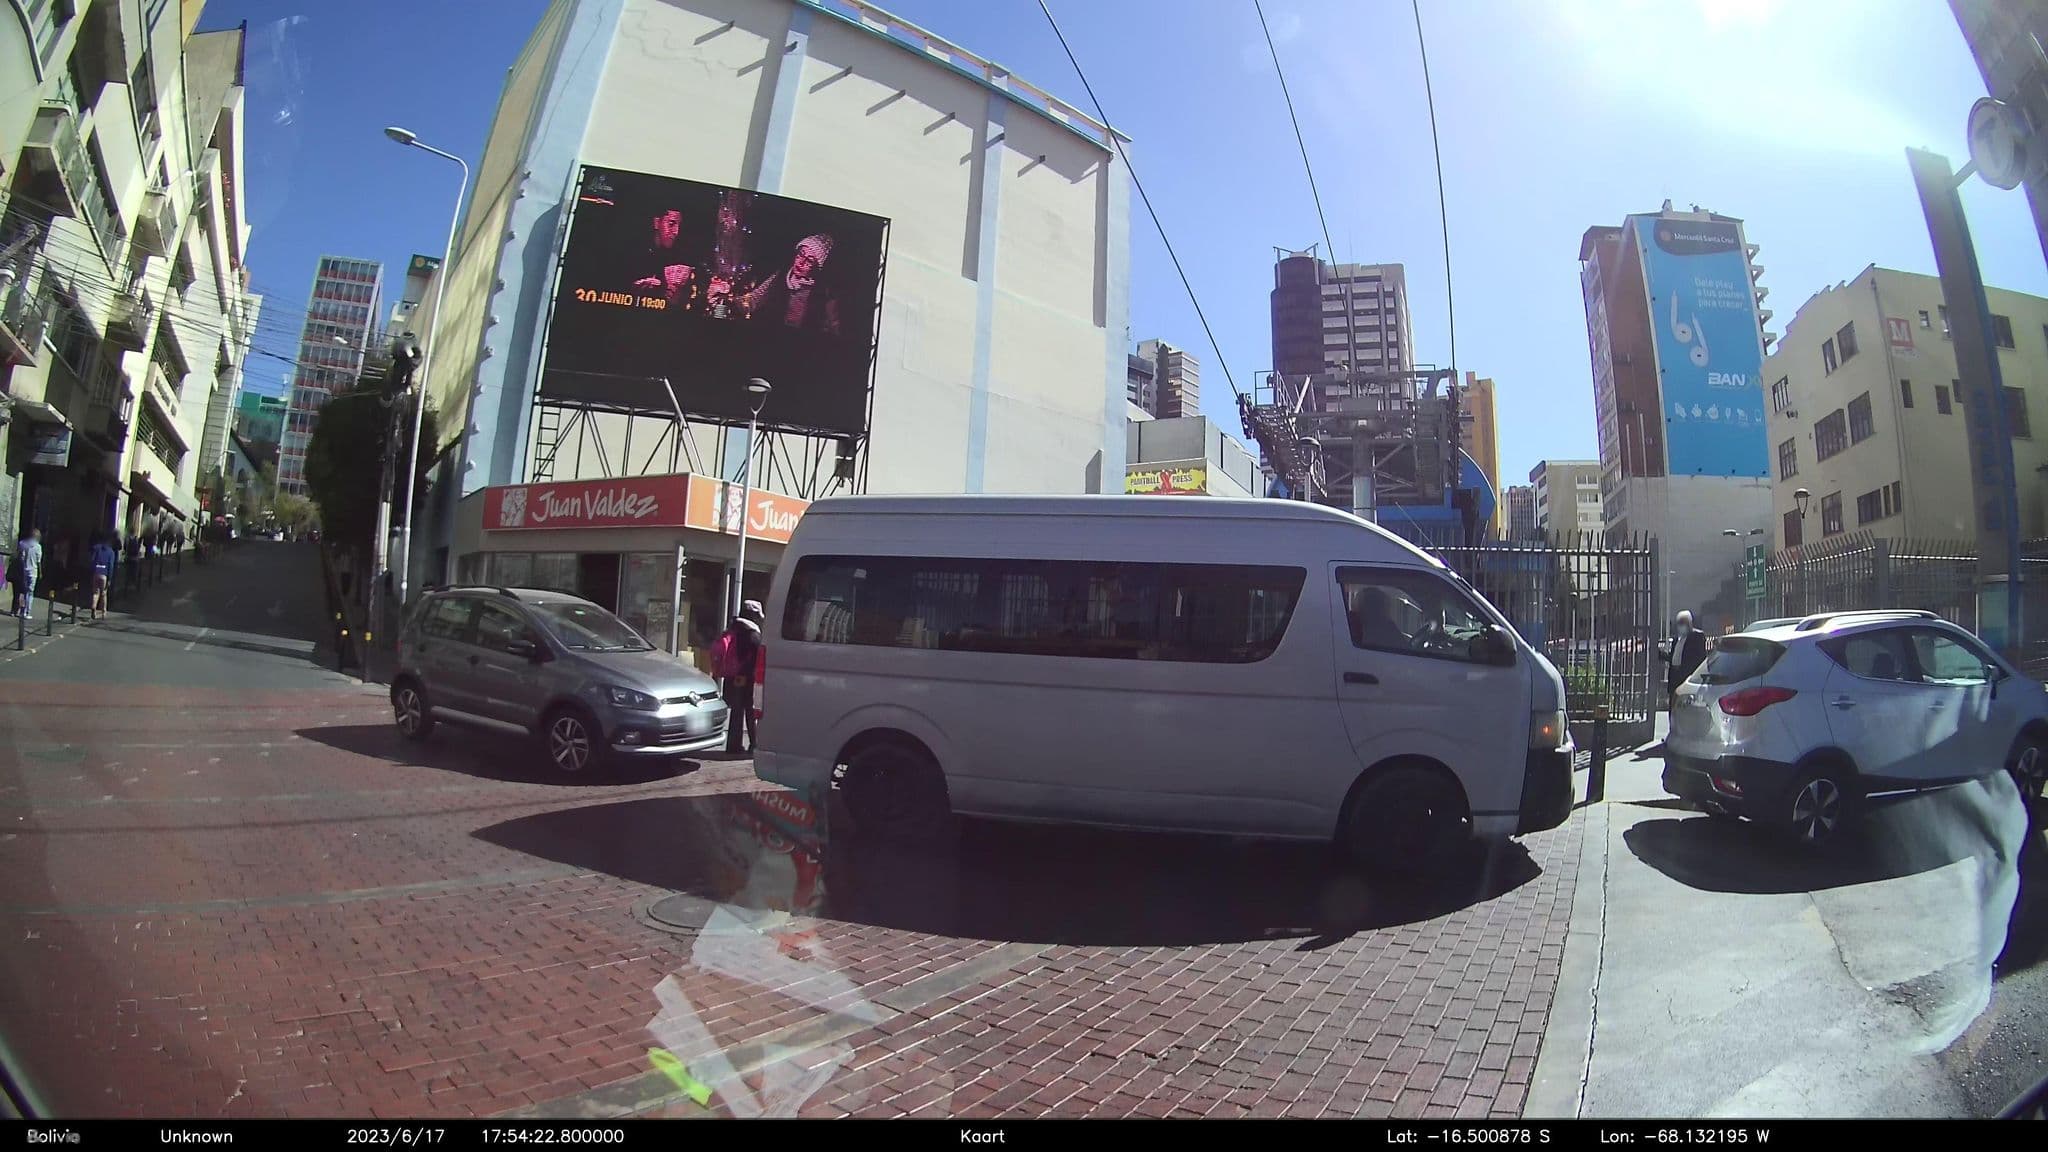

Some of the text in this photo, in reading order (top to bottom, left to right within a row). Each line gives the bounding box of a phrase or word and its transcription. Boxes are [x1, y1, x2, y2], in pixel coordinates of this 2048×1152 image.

[597, 291, 633, 306] JUNIO
[1888, 319, 1911, 343] M
[532, 487, 658, 523] Juan Valdez
[750, 500, 799, 533] Juan
